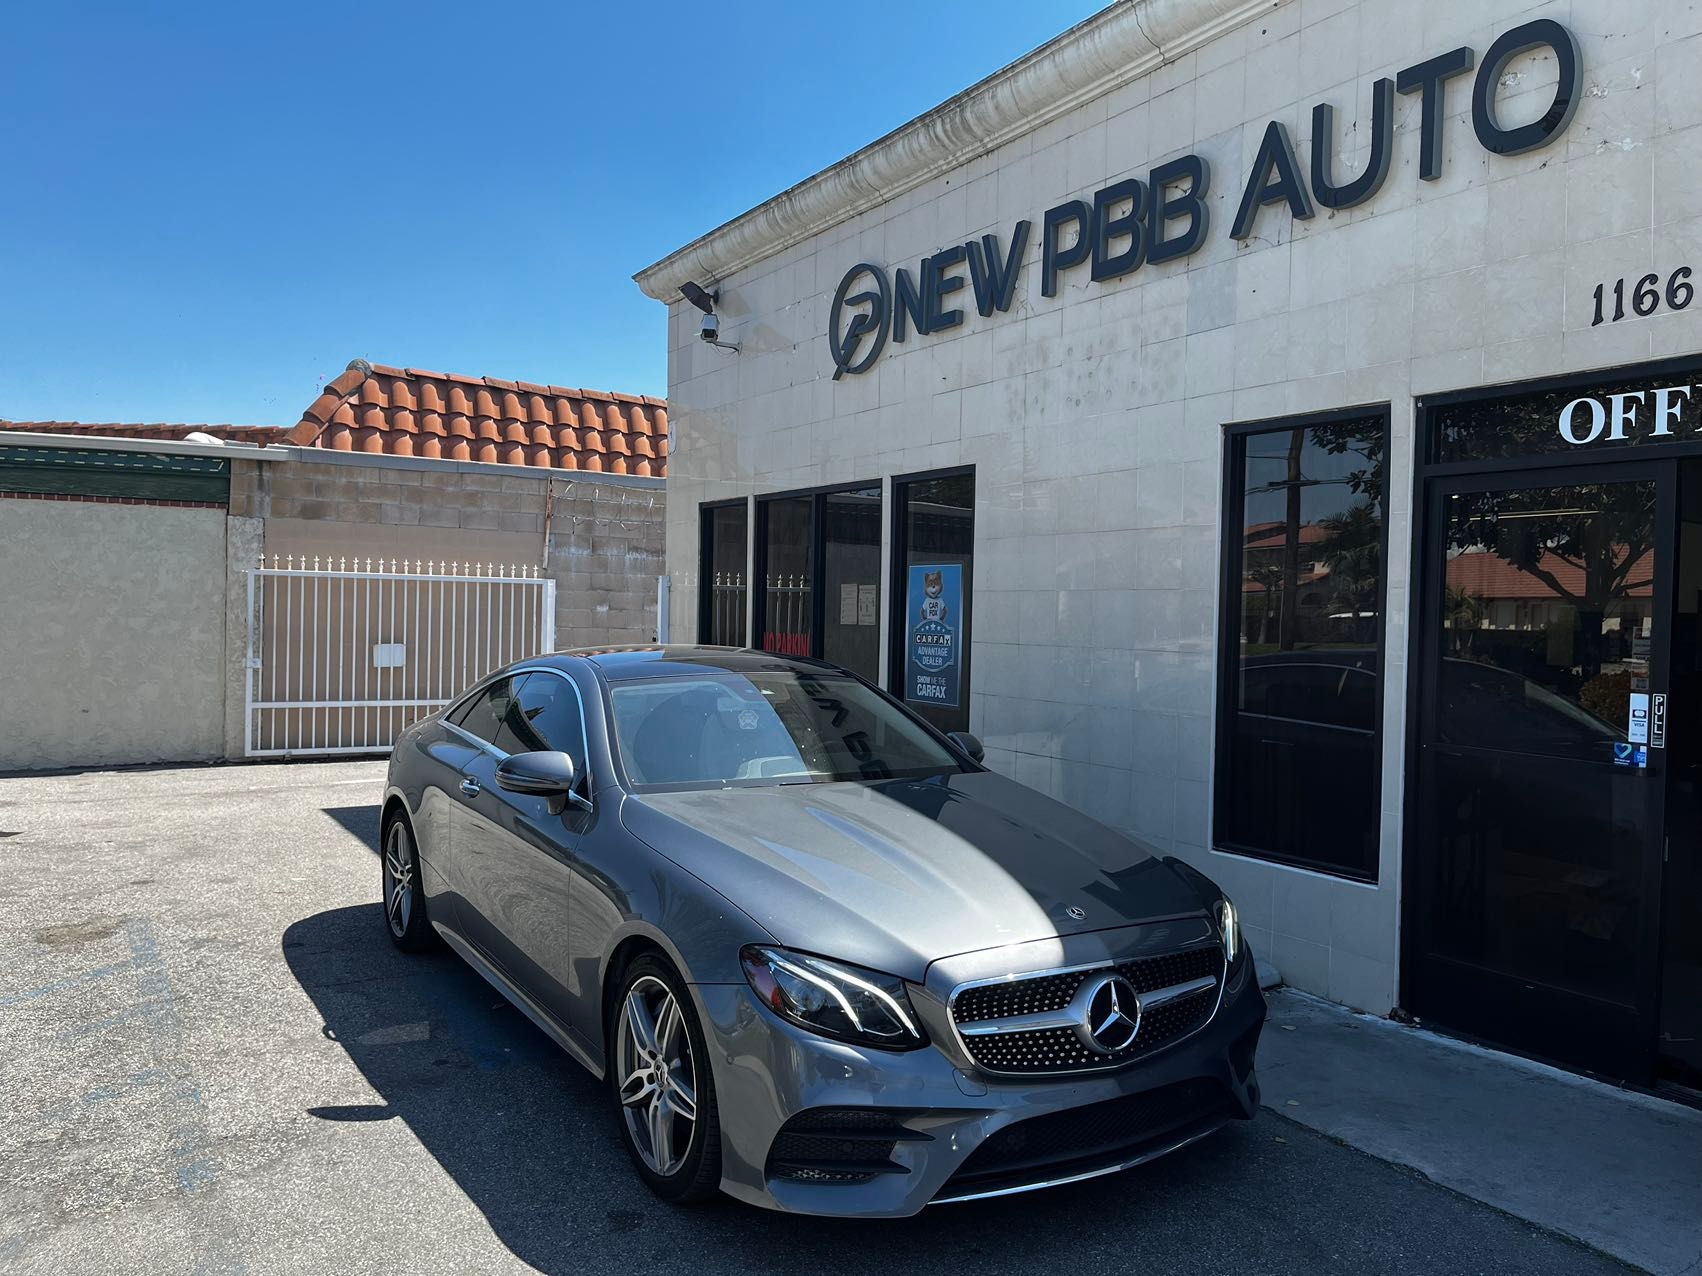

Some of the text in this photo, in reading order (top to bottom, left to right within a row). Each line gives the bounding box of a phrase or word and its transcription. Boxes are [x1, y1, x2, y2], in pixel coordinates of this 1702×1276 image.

[893, 219, 1031, 343] NEW
[1041, 154, 1210, 298] PBB
[1229, 18, 1584, 241] AUTO
[1591, 265, 1694, 327] 1166
[1558, 383, 1702, 444] OFF
[916, 634, 951, 646] CARFAX
[918, 647, 948, 656] ADVANTAGE
[923, 657, 943, 665] DEALER
[917, 676, 930, 684] SHOW
[917, 684, 947, 698] CARFAX
[1654, 696, 1663, 733] PULL
